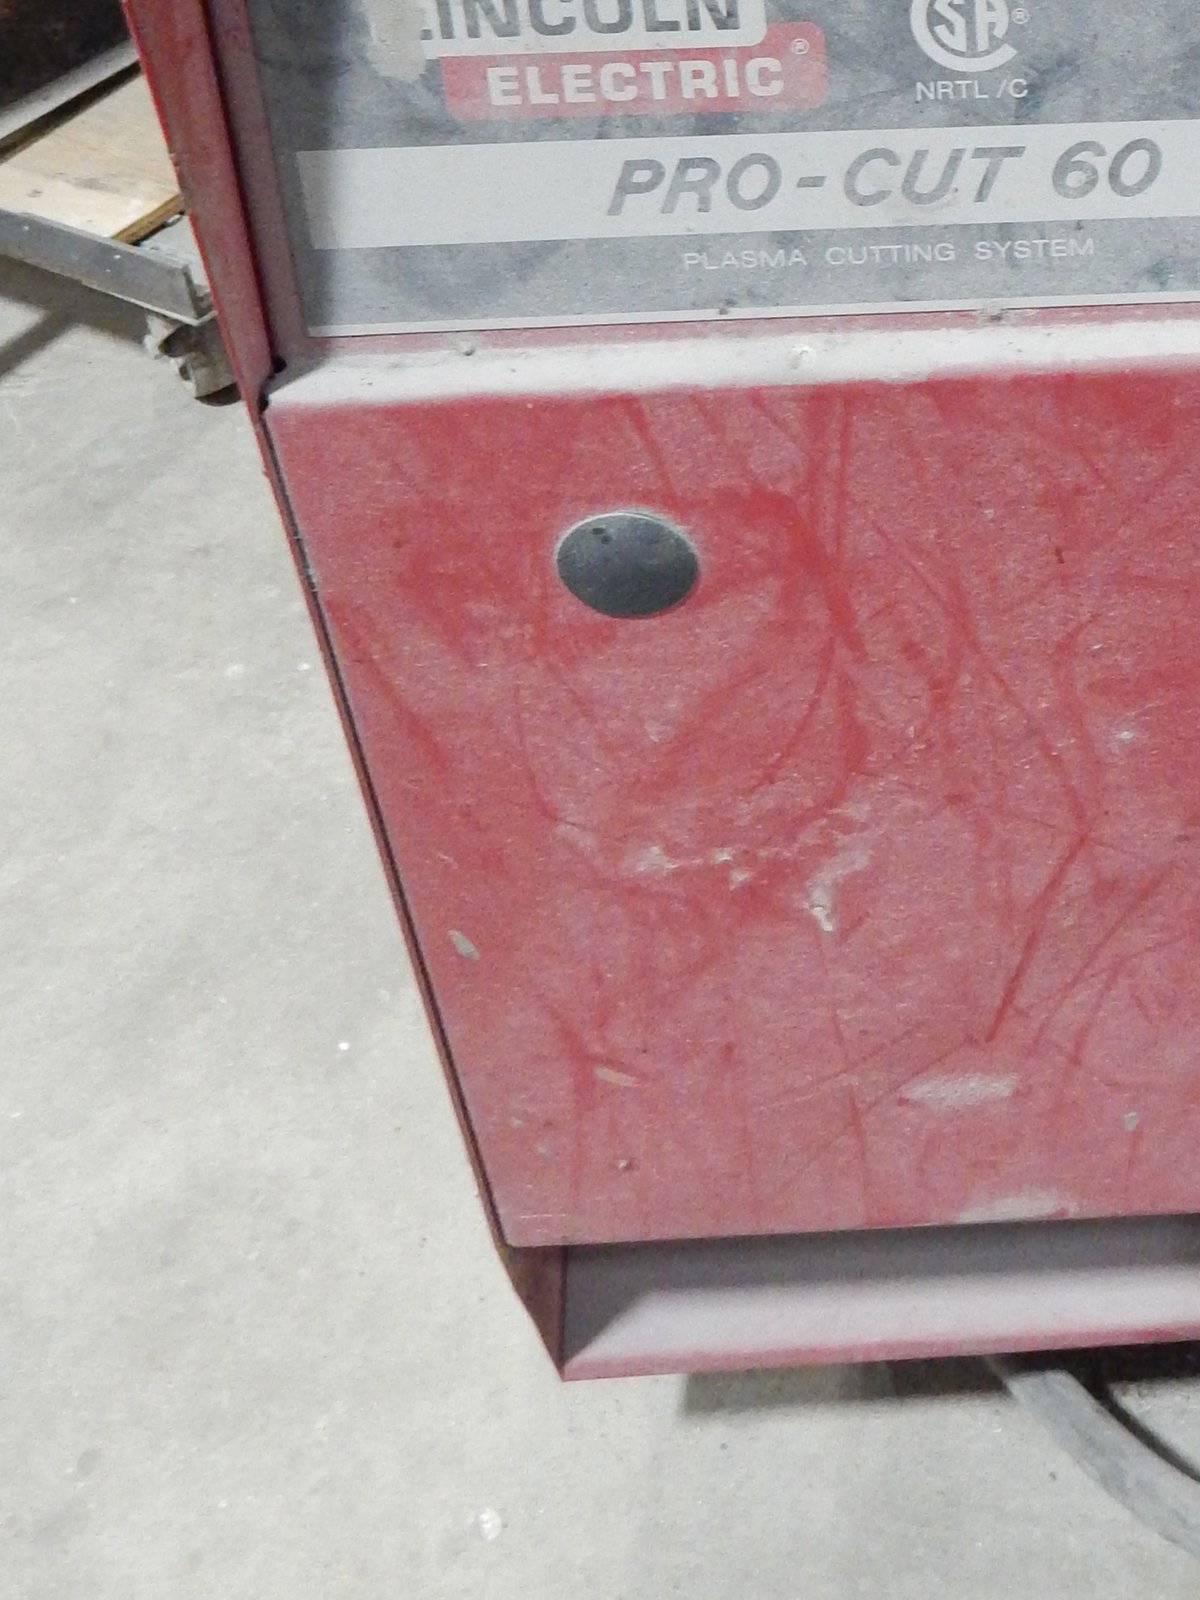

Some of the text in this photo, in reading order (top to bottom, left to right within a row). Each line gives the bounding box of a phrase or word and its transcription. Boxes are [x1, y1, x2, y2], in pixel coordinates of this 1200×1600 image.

[486, 56, 785, 107] ELECTRIC
[606, 137, 1165, 218] PRO-CUT 60
[683, 236, 1095, 272] PLASMA CUTTING SYSTEM
